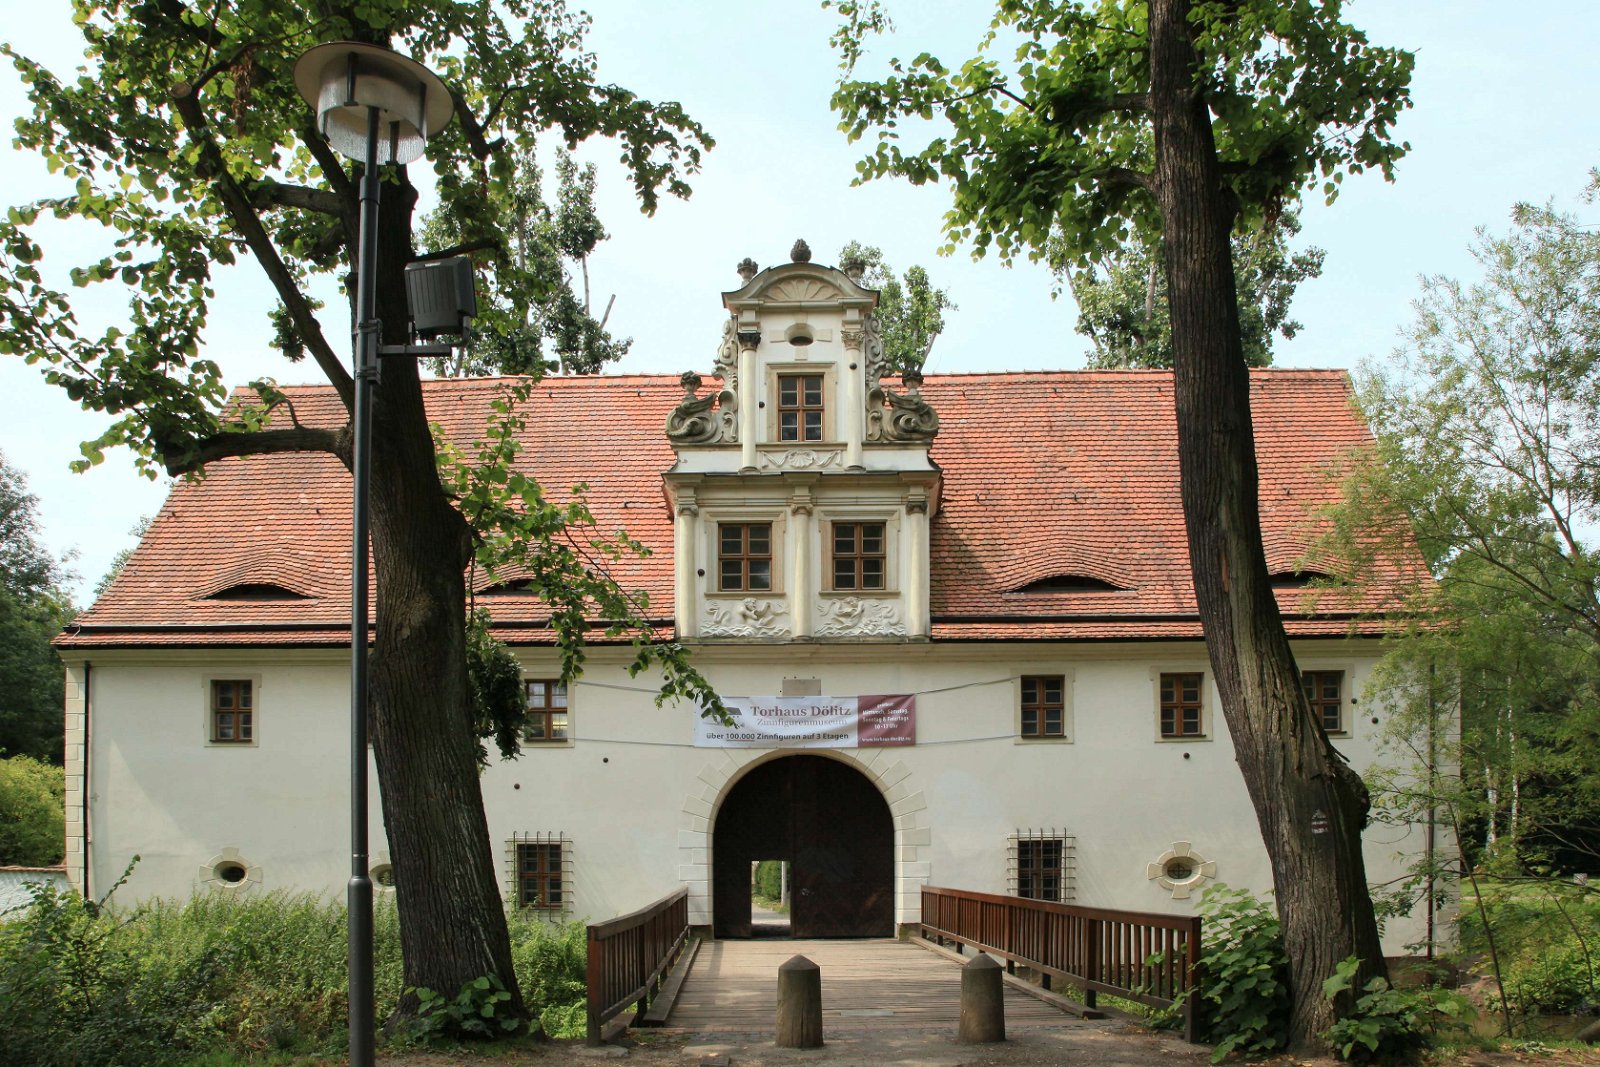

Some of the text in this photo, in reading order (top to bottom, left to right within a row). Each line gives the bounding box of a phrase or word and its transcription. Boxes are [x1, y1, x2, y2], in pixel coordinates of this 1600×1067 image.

[750, 705, 852, 717] Torhaus Dölitz
[706, 732, 724, 740] über
[756, 733, 801, 742] Zinnfiguren
[822, 733, 849, 741] Etagen
